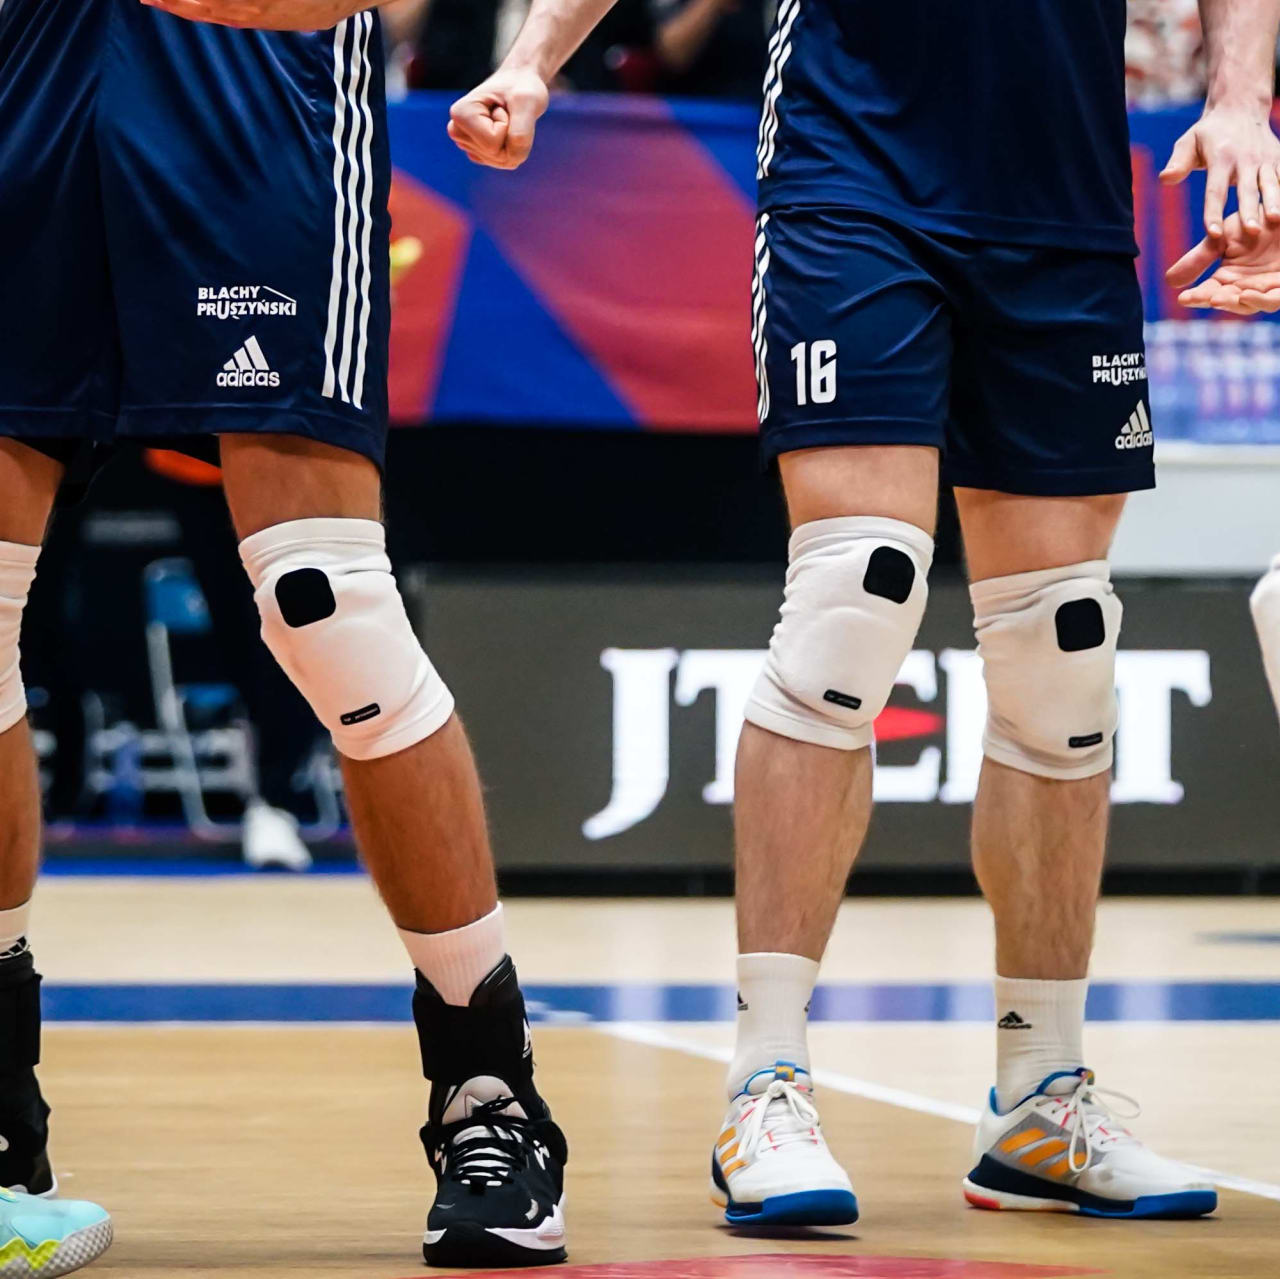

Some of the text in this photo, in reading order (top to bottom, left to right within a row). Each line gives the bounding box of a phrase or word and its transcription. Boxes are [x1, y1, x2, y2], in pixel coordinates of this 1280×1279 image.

[198, 286, 261, 300] BLACHY
[1092, 352, 1140, 368] BLACHY
[216, 368, 281, 387] adidas
[790, 339, 837, 406] 16
